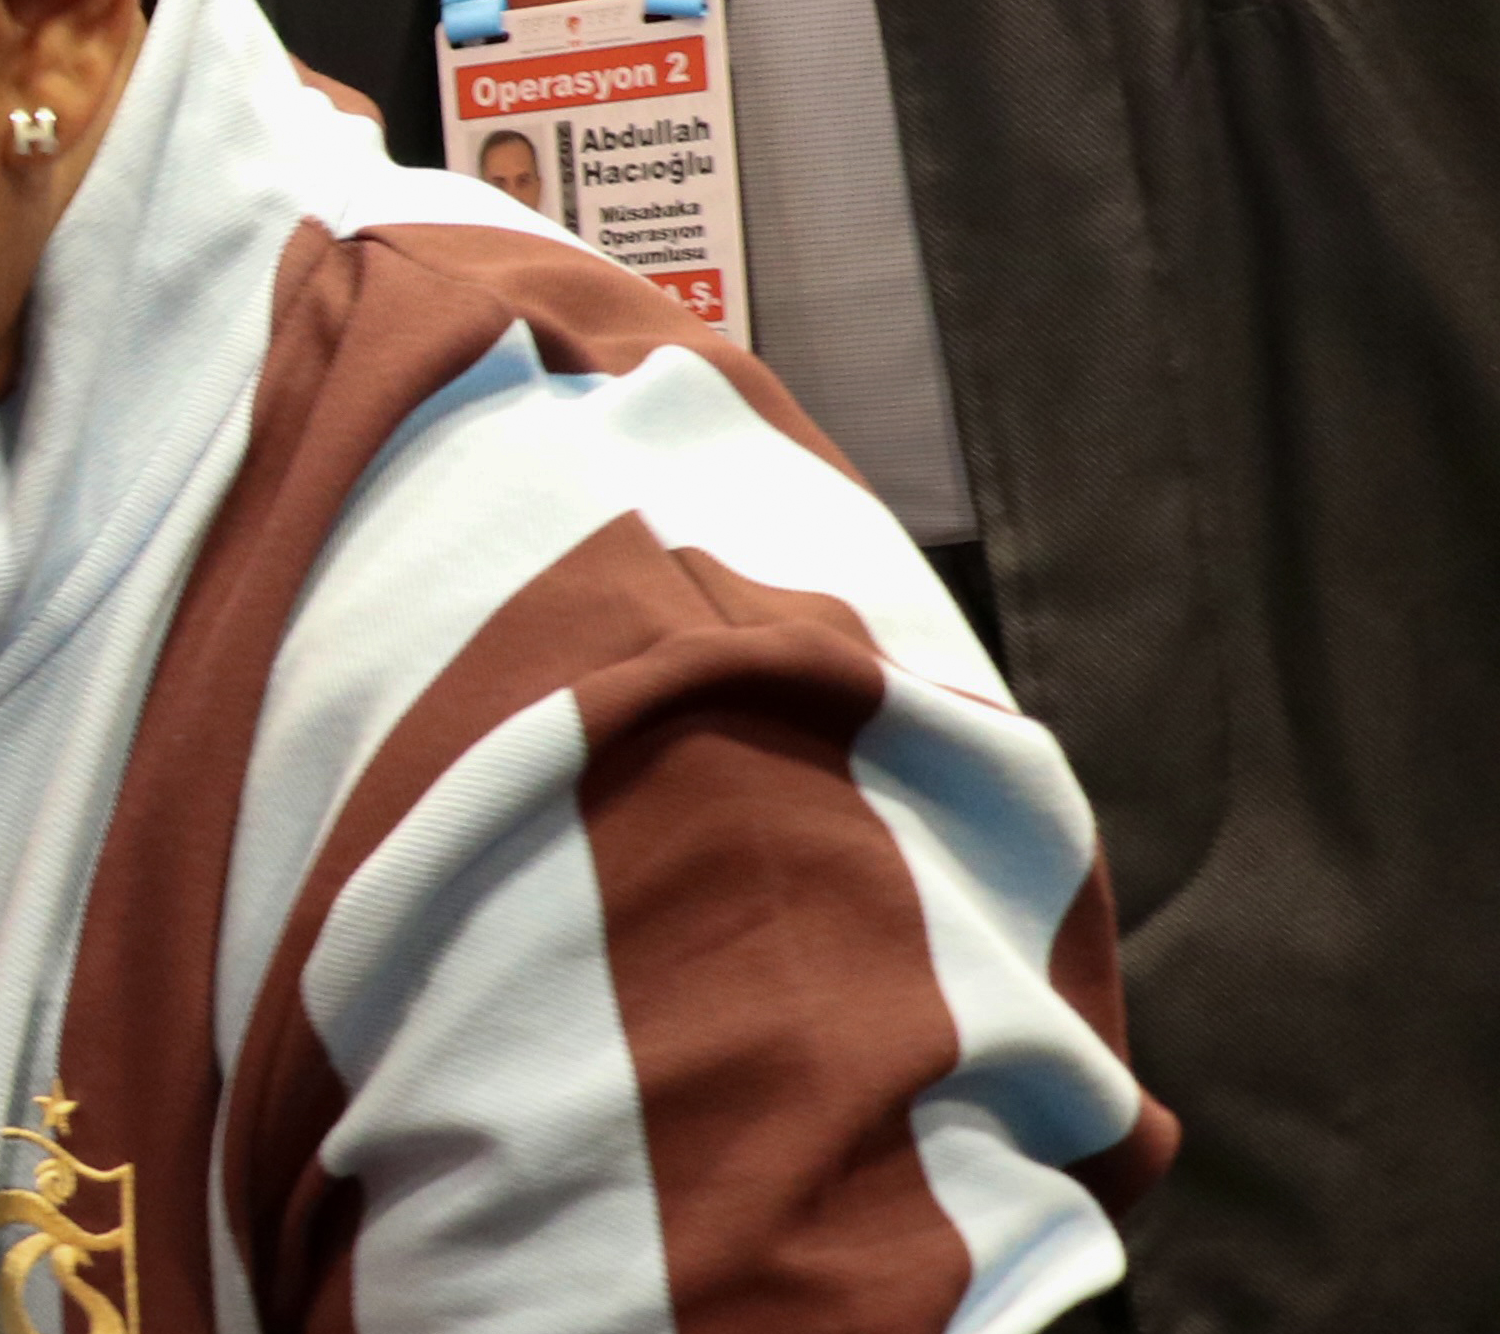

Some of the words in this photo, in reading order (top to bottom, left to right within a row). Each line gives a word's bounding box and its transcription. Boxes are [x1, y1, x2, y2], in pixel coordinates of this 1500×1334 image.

[471, 62, 657, 112] Operasyon
[664, 51, 691, 84] 2
[581, 117, 711, 153] Abdullah
[582, 152, 713, 185] Hacıoğlu
[599, 224, 704, 247] Operasyon
[604, 247, 706, 265] rumlusu
